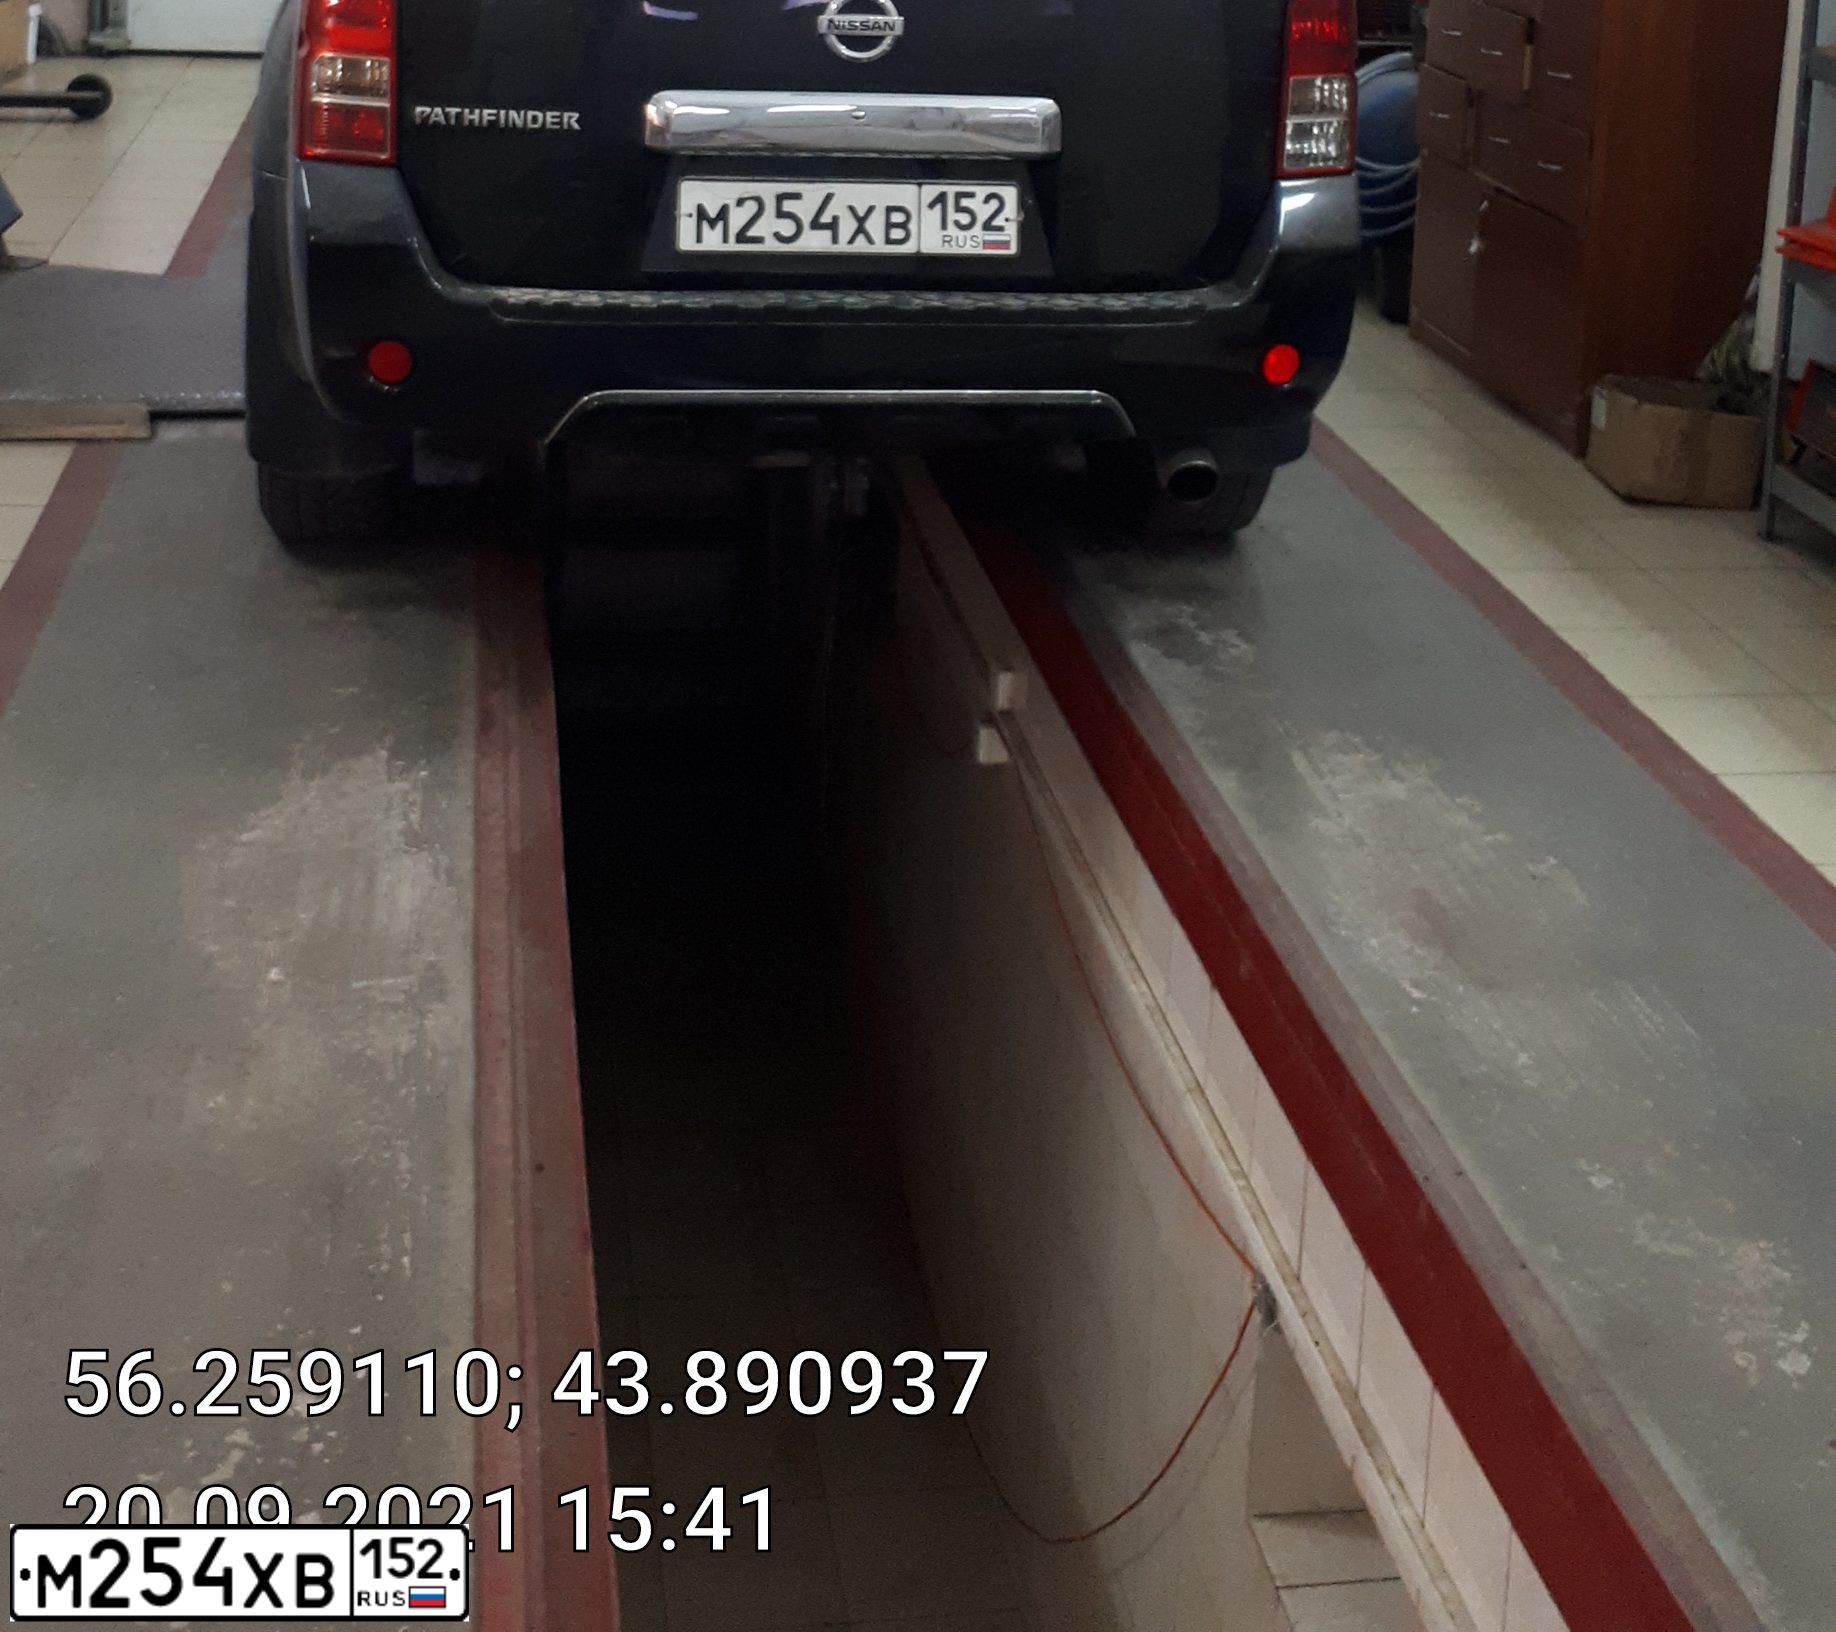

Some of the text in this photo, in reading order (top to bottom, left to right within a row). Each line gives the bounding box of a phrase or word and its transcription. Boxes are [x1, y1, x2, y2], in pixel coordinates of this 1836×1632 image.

[826, 17, 897, 33] NISSAN
[413, 104, 582, 131] PATHFINDER
[694, 189, 1006, 247] М254ХВ 152
[941, 233, 981, 249] RUS
